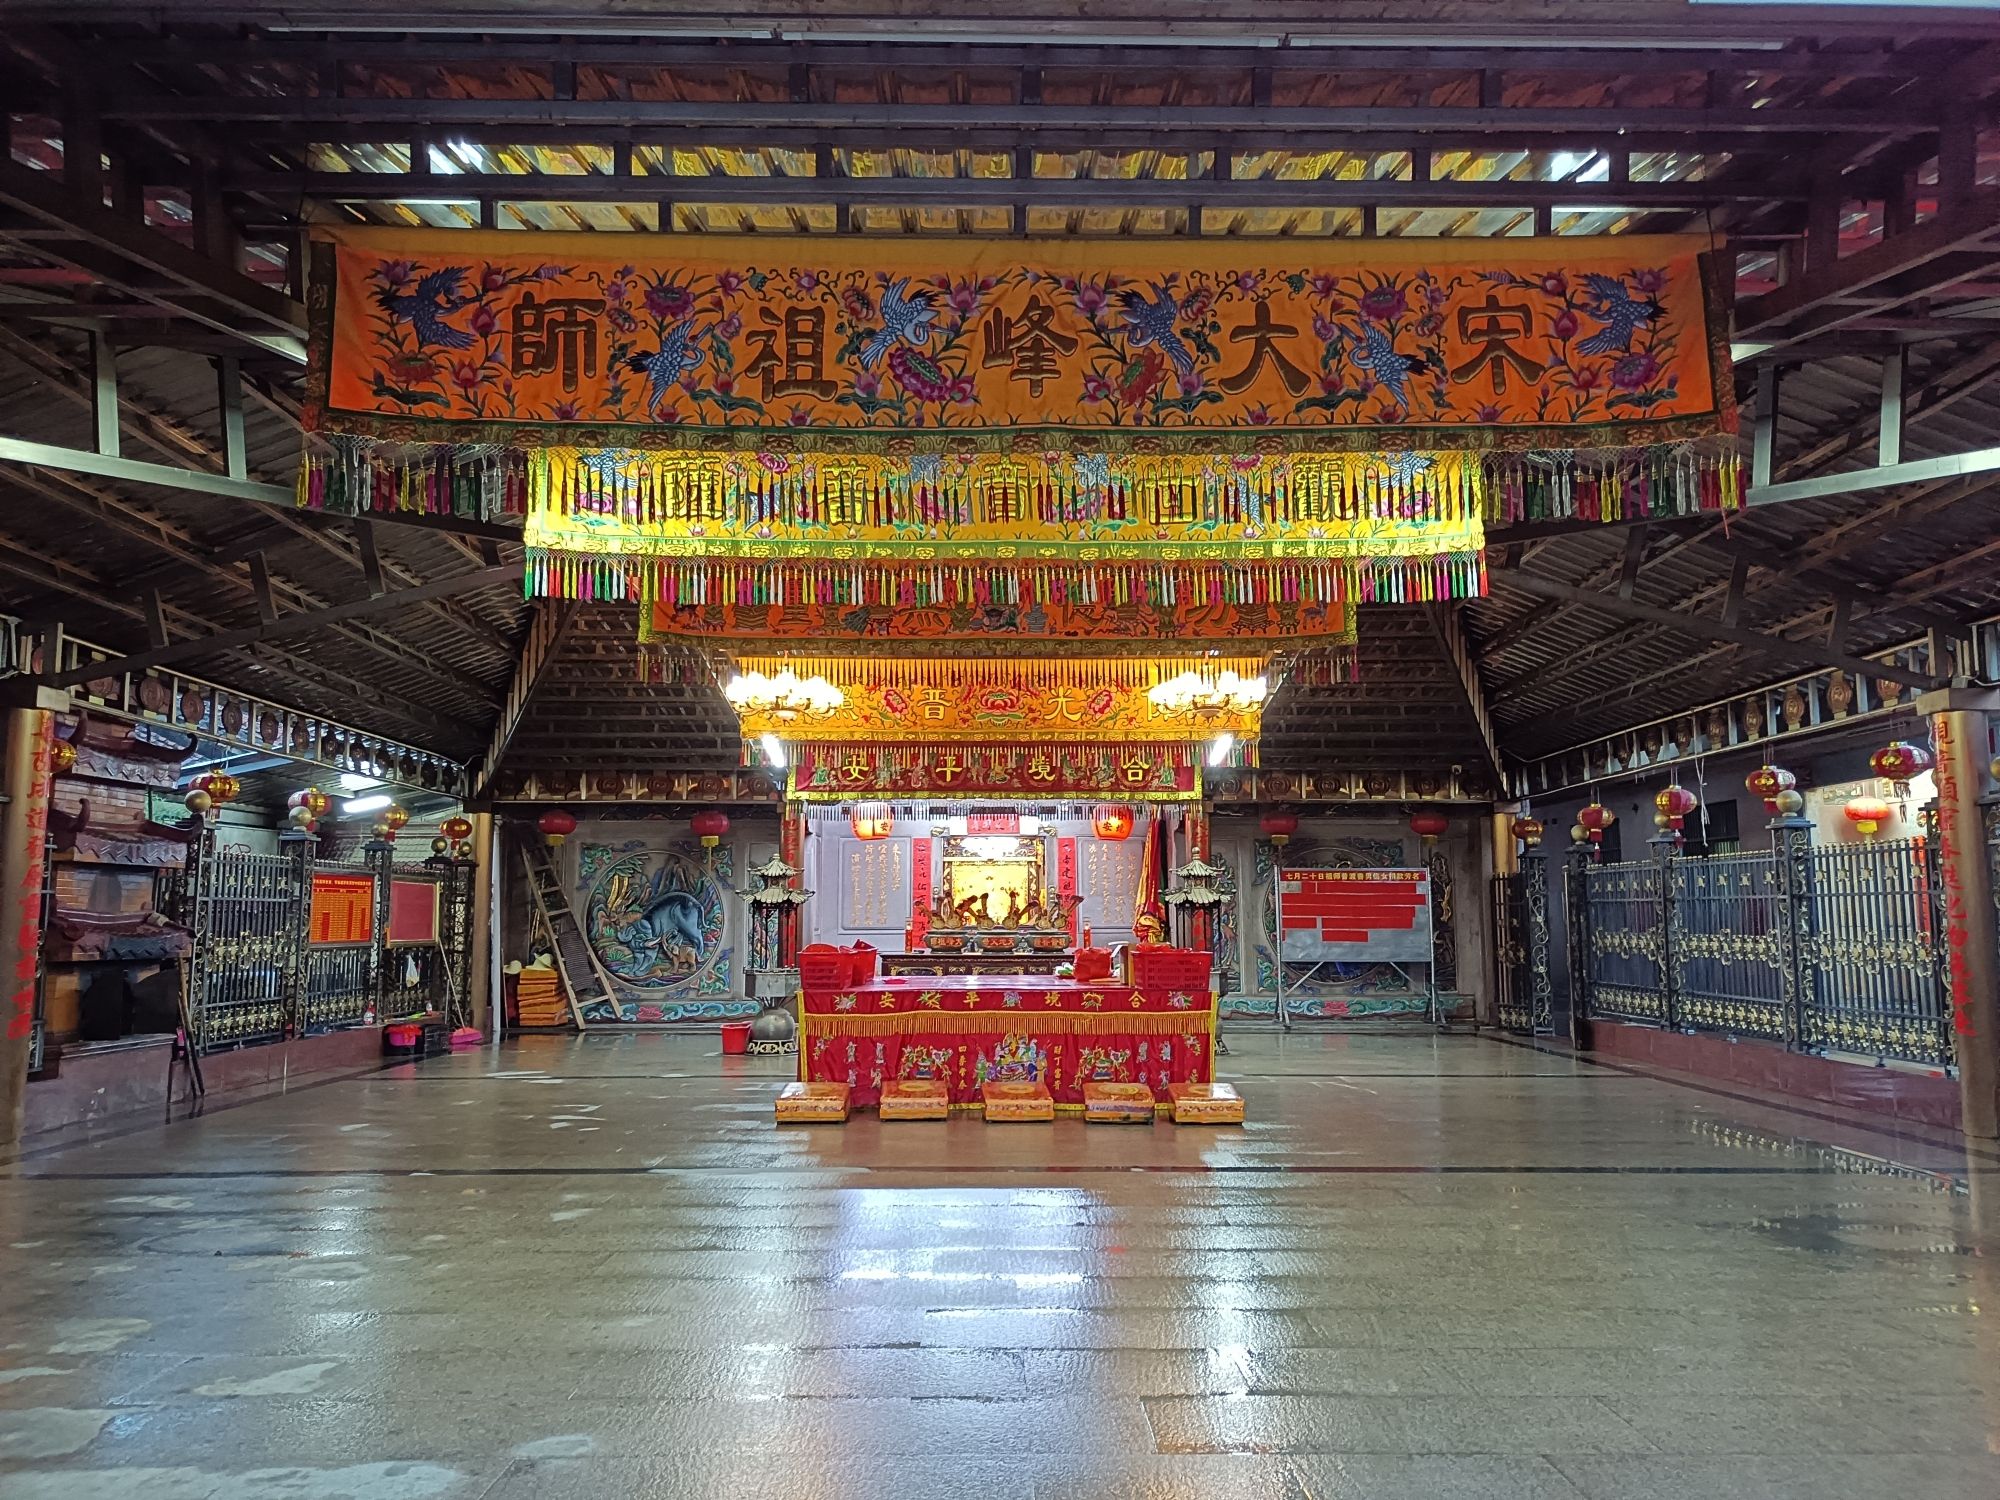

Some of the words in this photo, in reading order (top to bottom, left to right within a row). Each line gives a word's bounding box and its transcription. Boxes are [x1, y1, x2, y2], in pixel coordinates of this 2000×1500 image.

[511, 291, 1547, 403] 宋大峰祖師
[842, 754, 1149, 782] 合境平安
[879, 991, 1146, 1009] 合境平安
